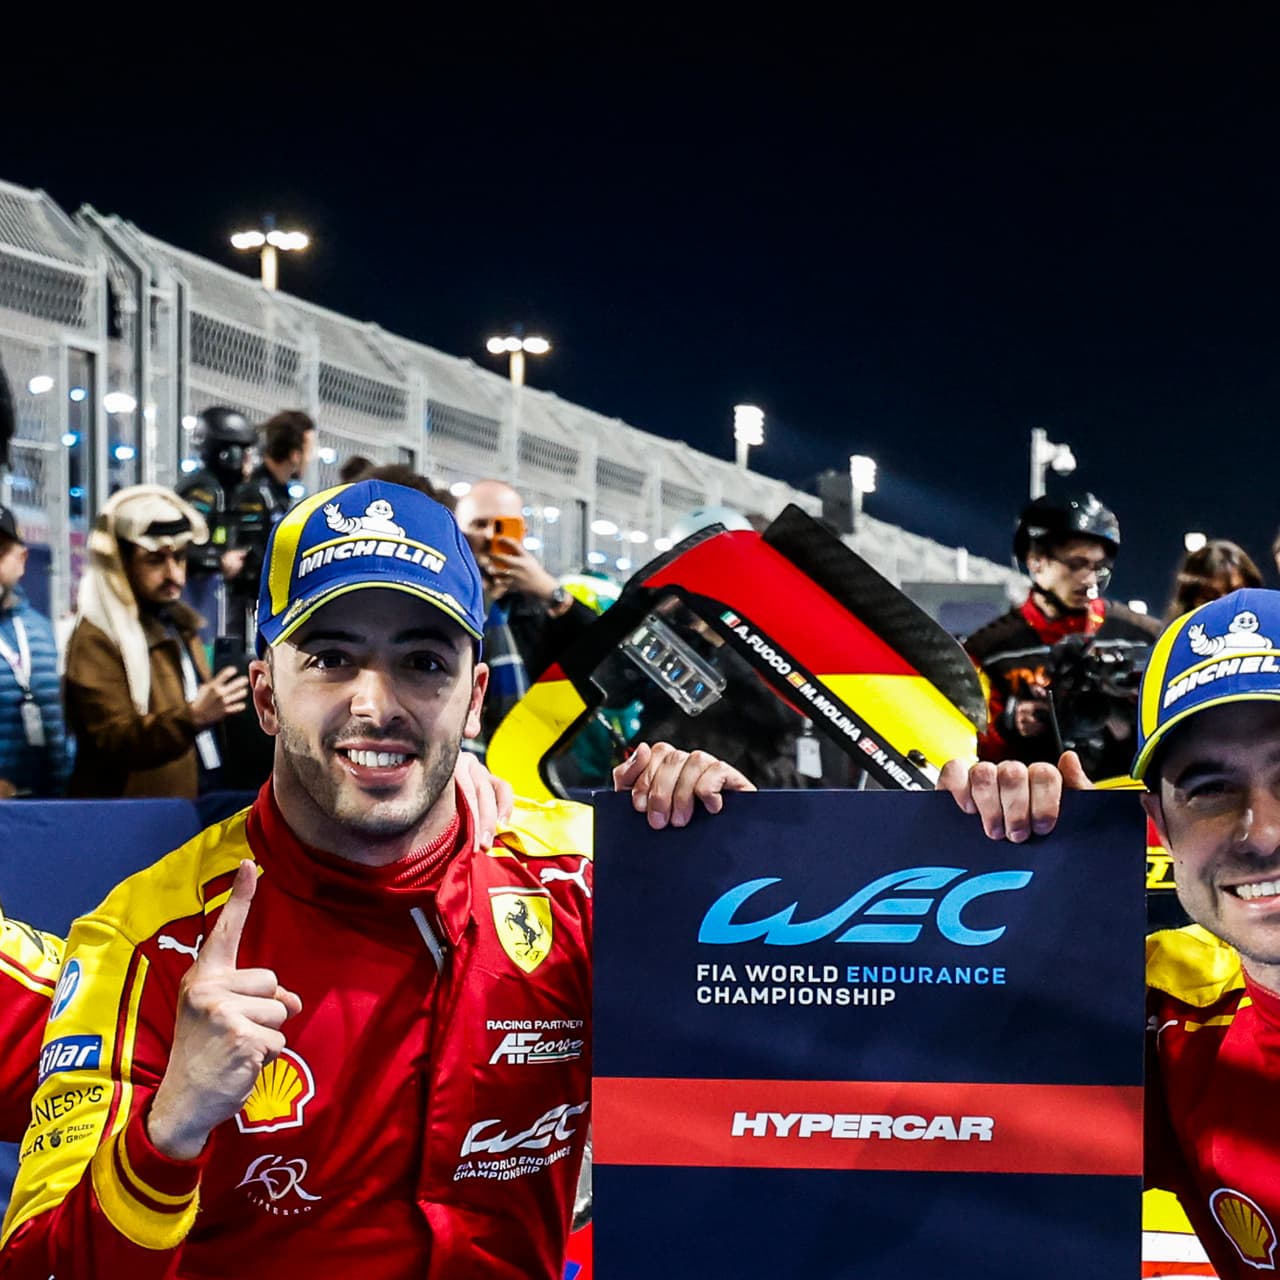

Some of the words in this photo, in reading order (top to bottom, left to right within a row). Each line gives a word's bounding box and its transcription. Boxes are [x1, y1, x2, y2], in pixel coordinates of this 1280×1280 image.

[298, 540, 445, 578] MICHELIN
[697, 866, 1034, 946] WEC
[697, 964, 736, 982] FIA
[745, 965, 838, 983] WORLD
[847, 965, 1007, 985] ENDURANCE
[697, 985, 896, 1006] CHAMPIONSHIP
[486, 1020, 532, 1030] RACING
[534, 1020, 583, 1030] PARTNER
[39, 1041, 99, 1079] tilar
[30, 1085, 104, 1128] NESYS
[460, 1100, 590, 1158] WEC
[731, 1112, 994, 1142] HYPERCAR
[453, 1165, 540, 1181] CHAMPIONSHIP
[477, 1156, 517, 1171] WORLD
[518, 1145, 570, 1166] ENDURANCE
